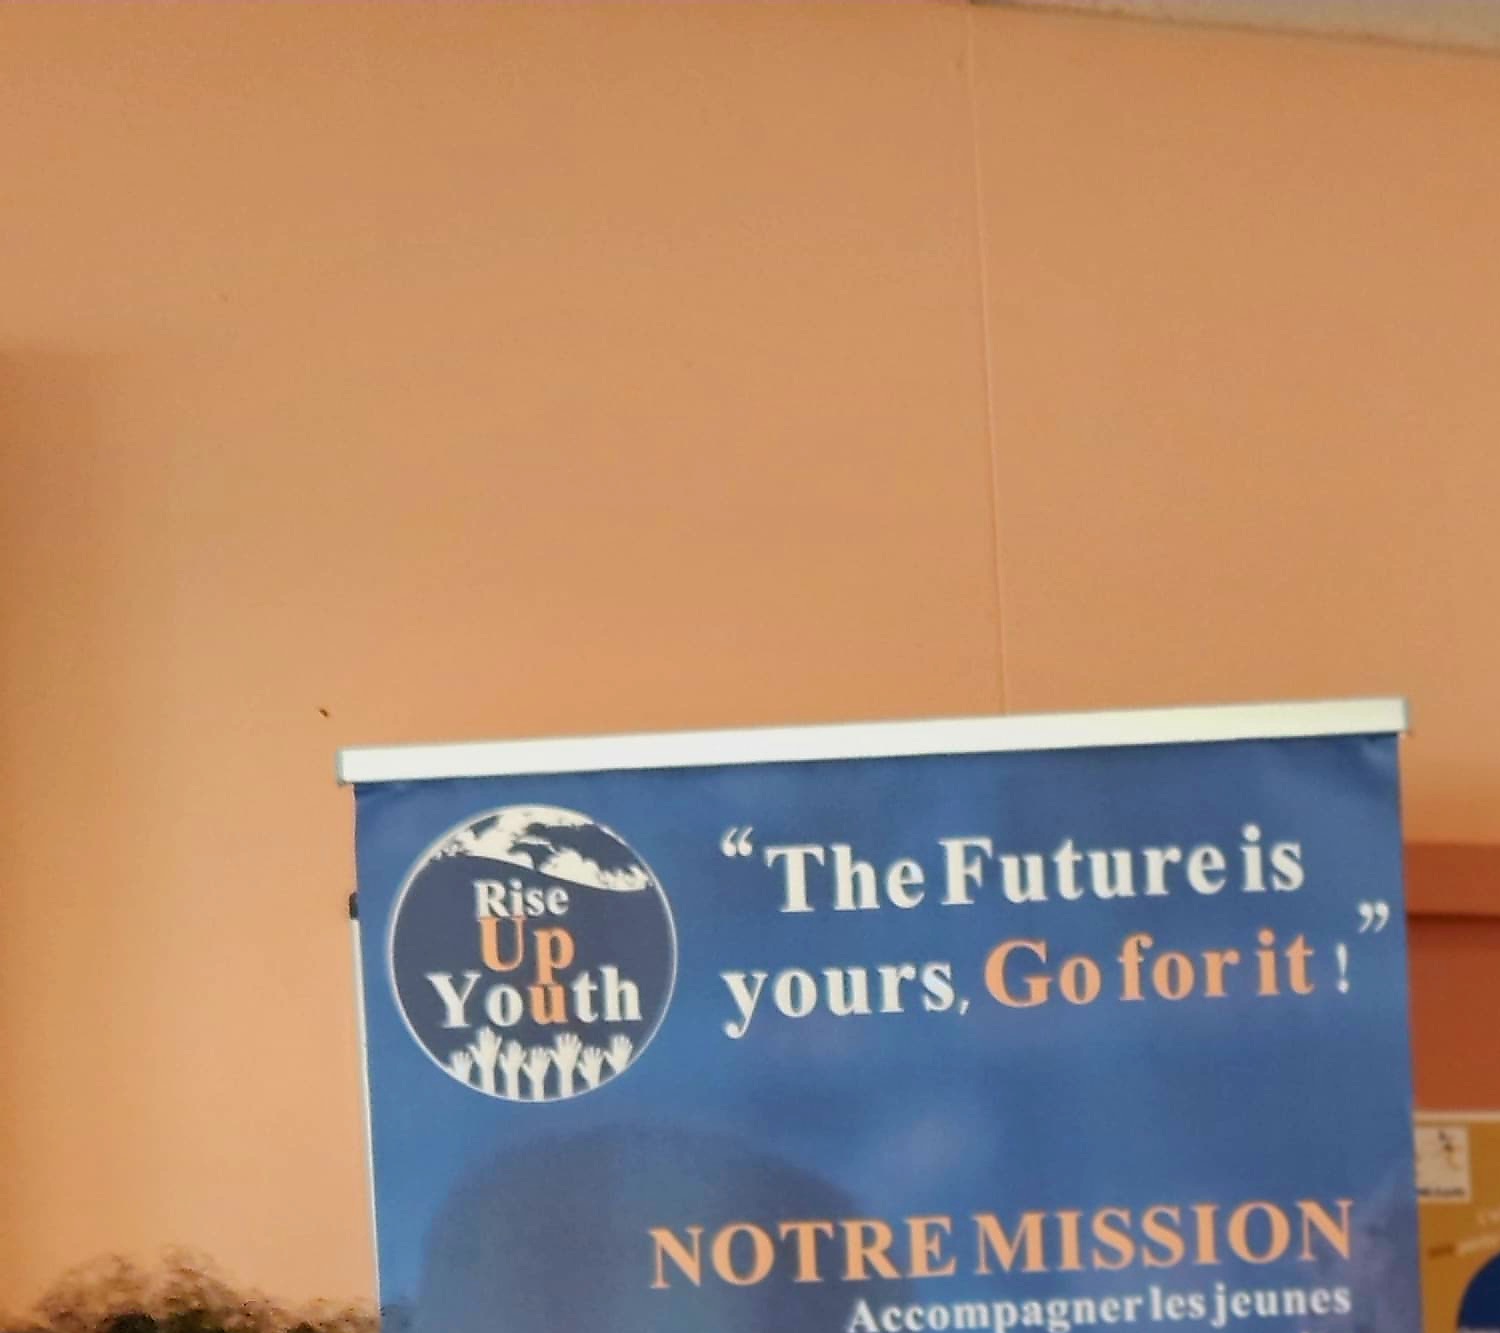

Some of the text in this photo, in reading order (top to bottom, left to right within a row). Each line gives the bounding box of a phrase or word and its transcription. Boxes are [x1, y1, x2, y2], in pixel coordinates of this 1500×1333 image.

[473, 879, 569, 918] Rise
[938, 836, 1228, 905] Future
[1239, 823, 1305, 893] is
[478, 916, 576, 985] Up
[719, 961, 971, 1040] yours,
[983, 938, 1103, 1010] Go
[1117, 930, 1241, 1002] for
[1254, 928, 1316, 997] it
[425, 964, 643, 1029] Youth
[648, 1215, 958, 1290] NOTRE
[971, 1198, 1354, 1276] MISSION
[1149, 1284, 1207, 1323] les
[1209, 1281, 1354, 1329] jeunes
